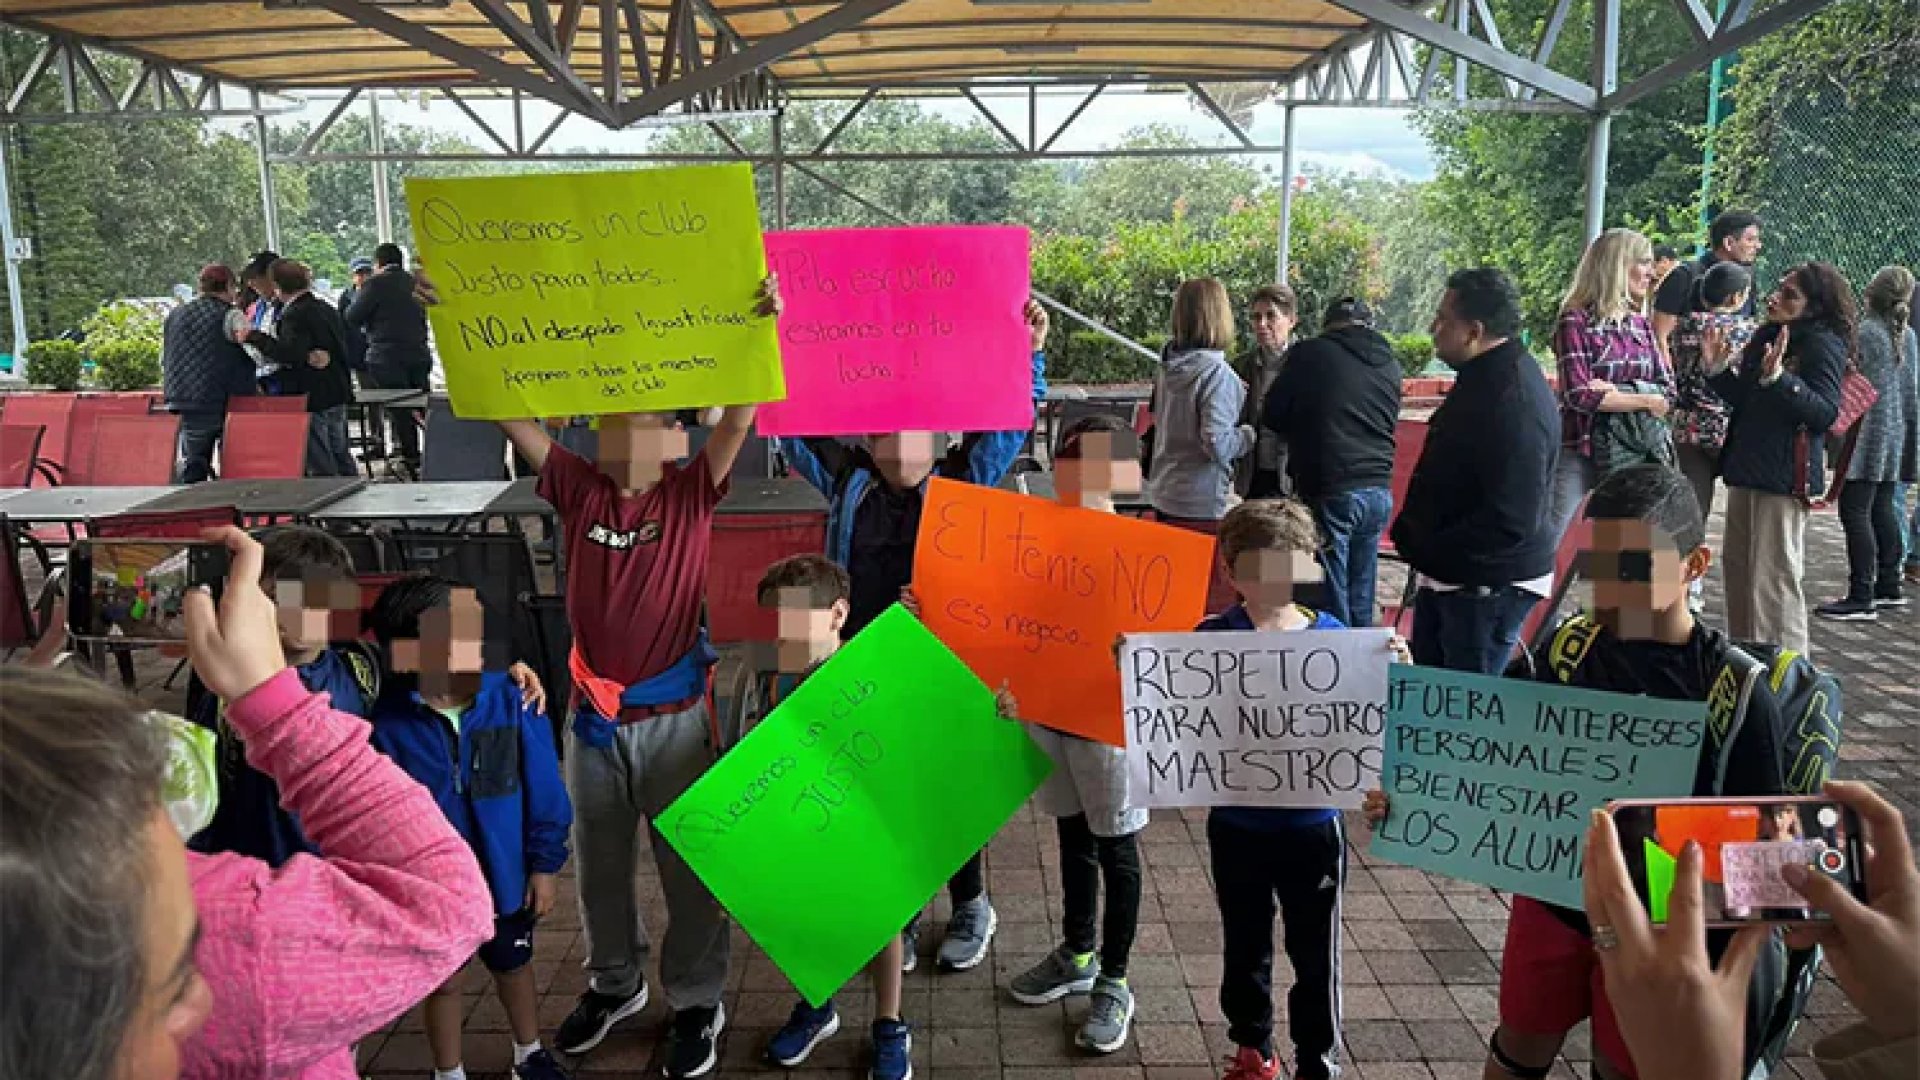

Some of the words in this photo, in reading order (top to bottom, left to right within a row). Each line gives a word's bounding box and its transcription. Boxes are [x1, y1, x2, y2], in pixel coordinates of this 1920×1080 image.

[424, 197, 584, 244] Queremos
[592, 211, 630, 238] un
[531, 271, 590, 300] para
[458, 314, 508, 351] NO
[511, 317, 536, 344] al
[543, 317, 626, 347] despido
[785, 319, 883, 344] estamos
[892, 320, 920, 337] en
[929, 312, 953, 337] tu
[934, 501, 988, 563] El
[1007, 511, 1097, 597] tenis
[1113, 547, 1172, 623] NO
[946, 598, 992, 629] es
[1131, 647, 1341, 700] RESPETO
[1125, 704, 1222, 745] PARA
[1534, 699, 1702, 749] INTERESES
[1395, 723, 1639, 786] PERSONALES!
[674, 753, 797, 857] Queremos
[799, 720, 828, 748] un
[791, 730, 884, 833] JUSTO
[1393, 763, 1579, 824] BIENESTAR
[1379, 808, 1460, 856] LOS
[1471, 819, 1583, 881] ALUM
